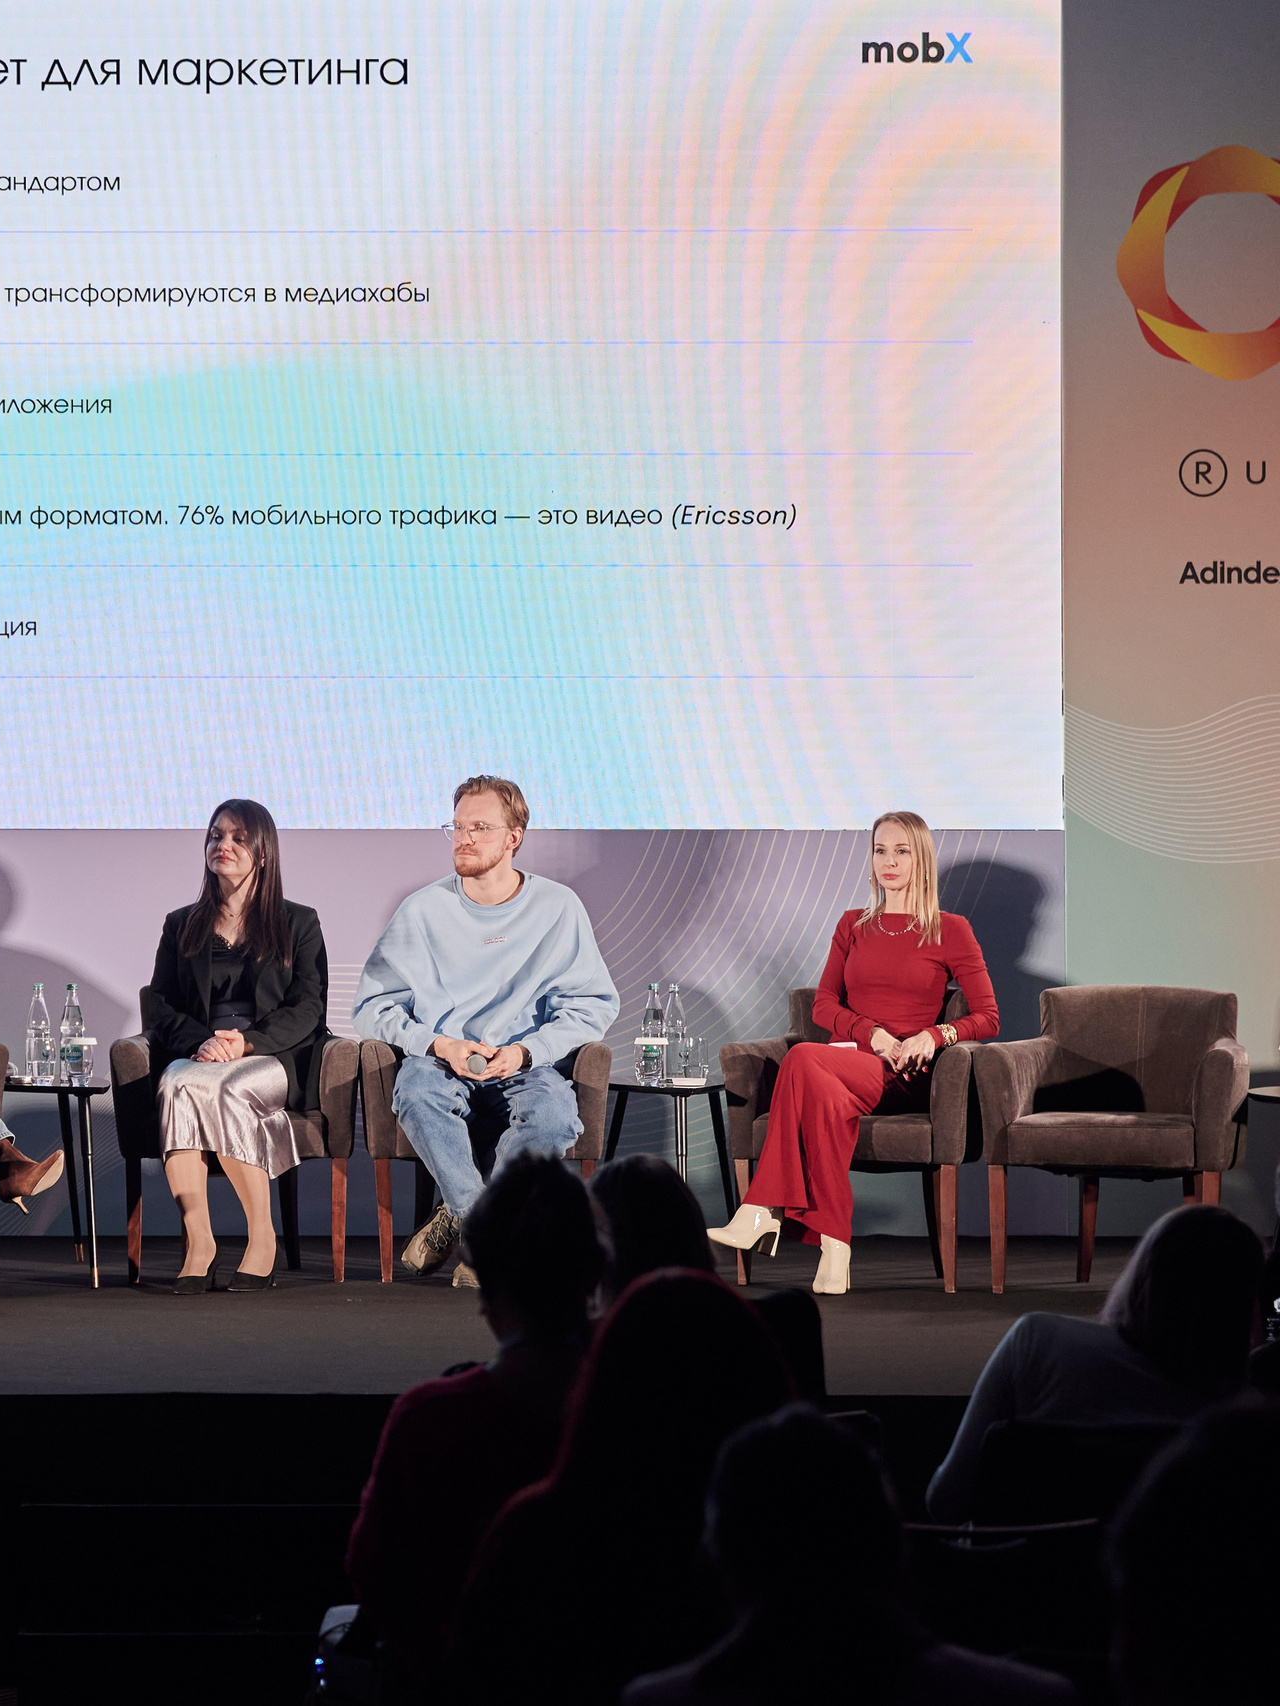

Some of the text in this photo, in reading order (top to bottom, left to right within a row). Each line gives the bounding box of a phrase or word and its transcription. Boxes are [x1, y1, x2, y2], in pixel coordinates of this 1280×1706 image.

[861, 31, 973, 64] mobX
[41, 58, 121, 92] для
[138, 57, 408, 95] маркетинга
[4, 282, 256, 307] трансформируются
[264, 287, 277, 303] в
[285, 281, 431, 306] медиахабы
[29, 505, 169, 530] форматом.
[177, 505, 225, 526] 76%
[232, 504, 382, 526] мобильного
[389, 504, 497, 530] трафика
[537, 509, 578, 526] это
[586, 509, 663, 528] видео
[671, 503, 798, 531] (Ericsson)
[1179, 560, 1280, 585] Adinde
